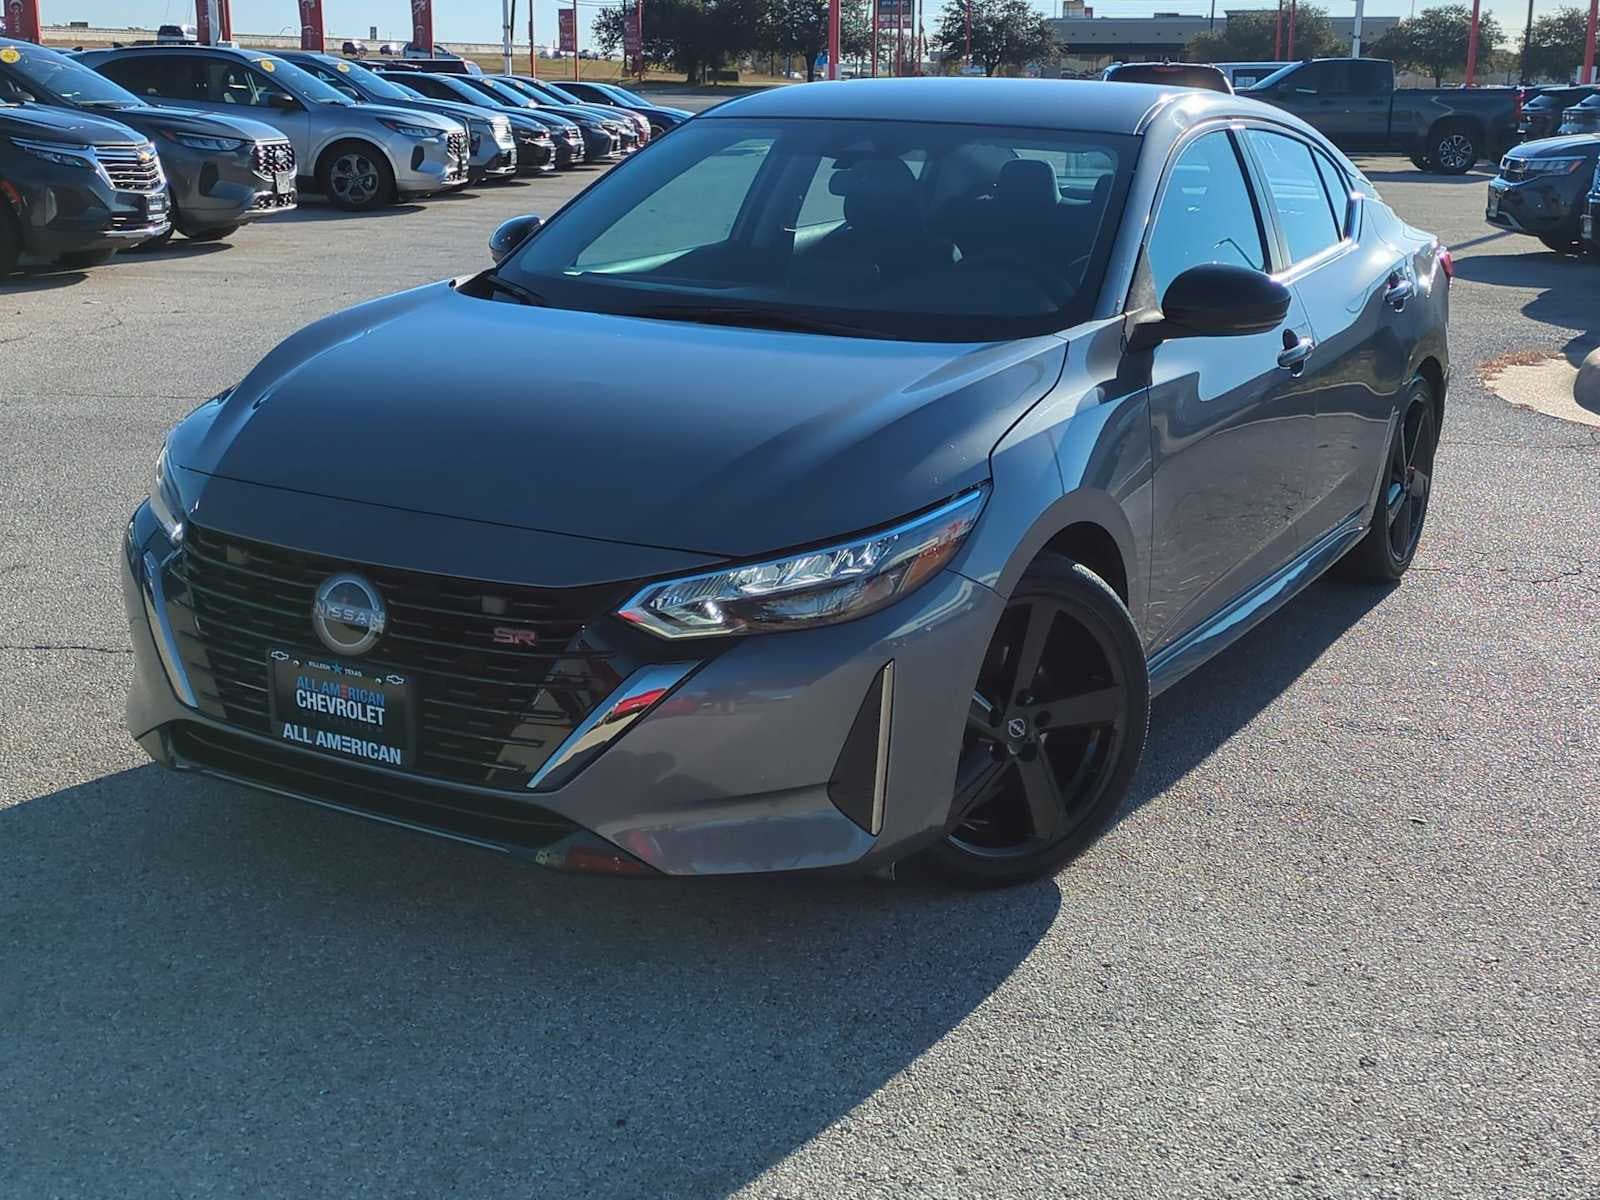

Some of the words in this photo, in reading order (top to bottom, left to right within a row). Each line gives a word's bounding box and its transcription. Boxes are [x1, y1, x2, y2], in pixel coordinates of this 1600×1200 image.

[313, 600, 385, 626] NISSAN
[494, 628, 536, 646] SR
[296, 676, 318, 693] ALL
[321, 682, 385, 706] AMERICAN
[296, 689, 385, 726] CHEVROLET
[282, 723, 313, 744] ALL
[315, 731, 401, 765] AMERICAN
